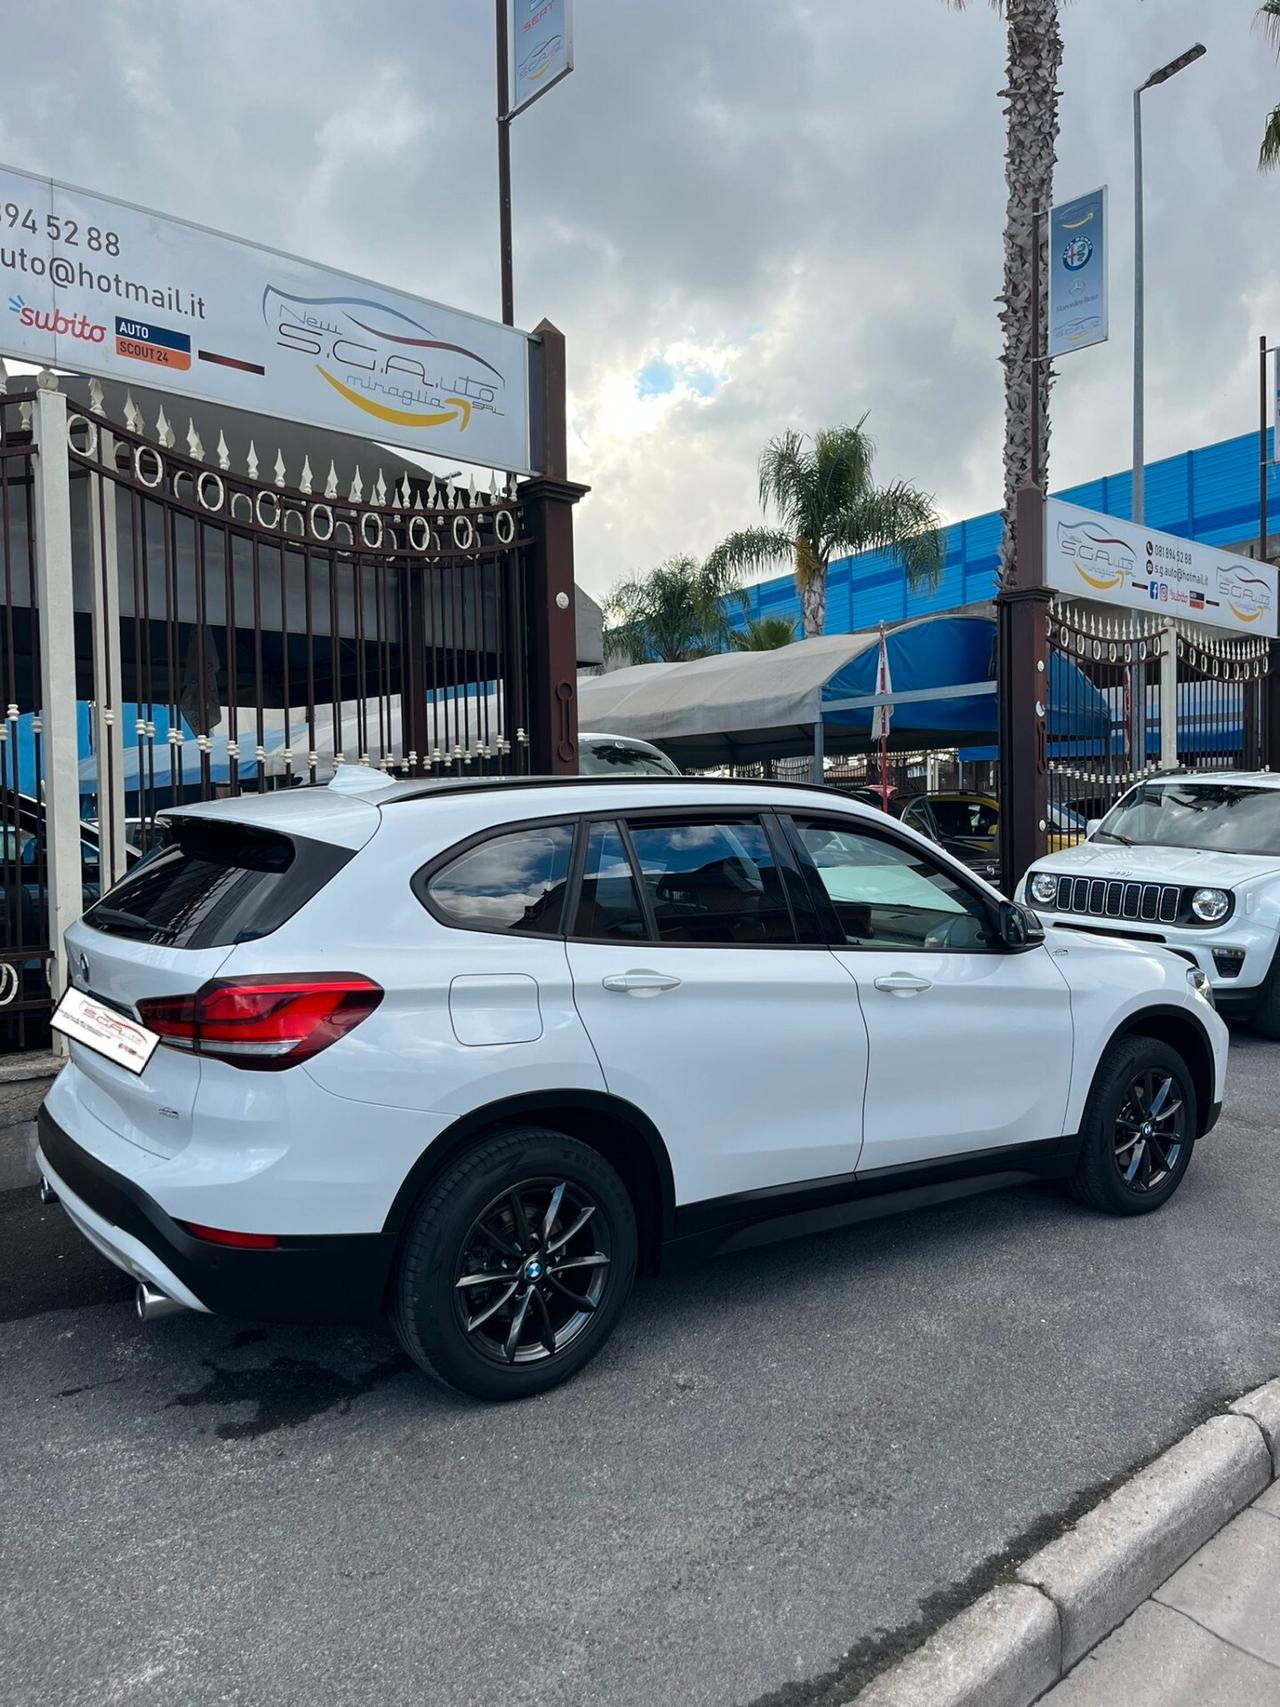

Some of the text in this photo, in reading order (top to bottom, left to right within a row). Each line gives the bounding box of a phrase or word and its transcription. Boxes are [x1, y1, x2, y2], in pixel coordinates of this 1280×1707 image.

[0, 203, 121, 257] 94 52 88
[19, 306, 107, 344] subito
[119, 320, 149, 340] AUTO
[119, 340, 169, 363] SCOUT 24
[346, 375, 446, 409] miraglia
